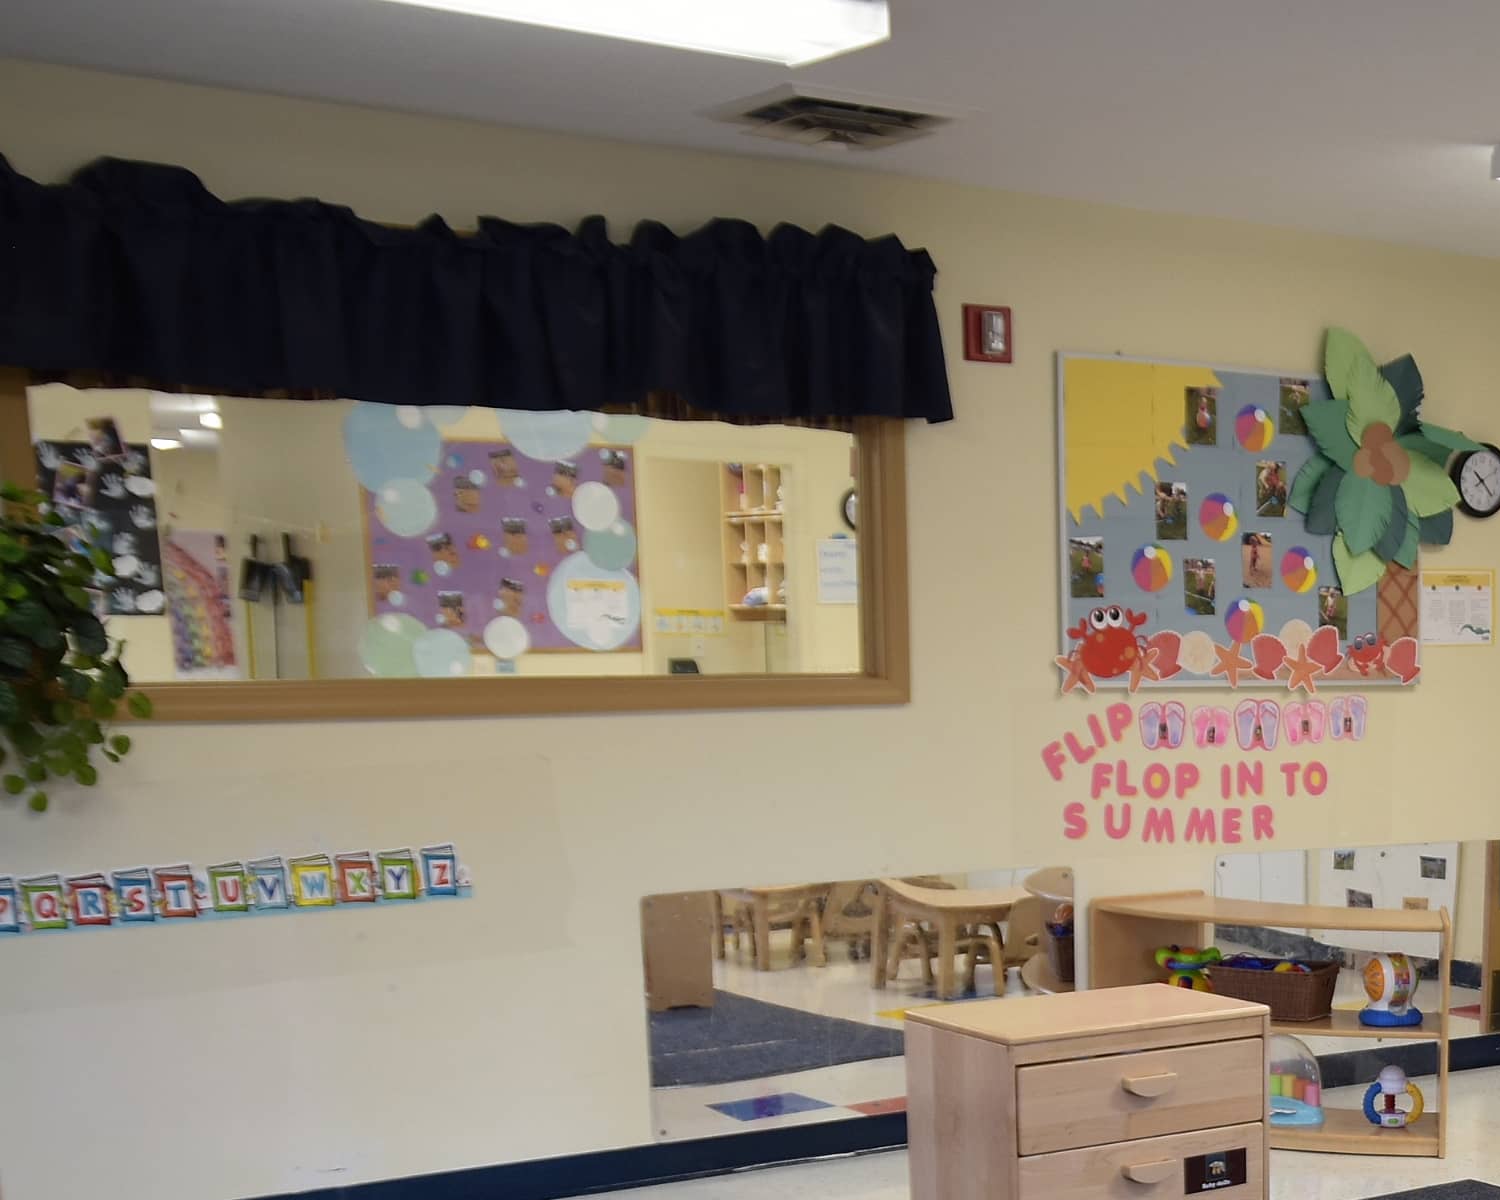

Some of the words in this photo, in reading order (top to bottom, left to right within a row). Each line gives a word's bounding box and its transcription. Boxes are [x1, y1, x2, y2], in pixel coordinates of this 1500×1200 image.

[1041, 702, 1134, 782] FLIP
[1091, 760, 1200, 799] FLOP
[1221, 760, 1264, 799] IN
[1280, 761, 1328, 798] TO
[1063, 802, 1275, 844] SUMMER
[36, 893, 59, 918] Q
[79, 890, 99, 914] R
[129, 887, 147, 912] S
[167, 884, 188, 908] T
[219, 880, 239, 903] U
[258, 877, 281, 899] V
[302, 873, 327, 897] W
[348, 871, 368, 895] X
[386, 867, 407, 892] Y
[432, 863, 450, 886] Z
